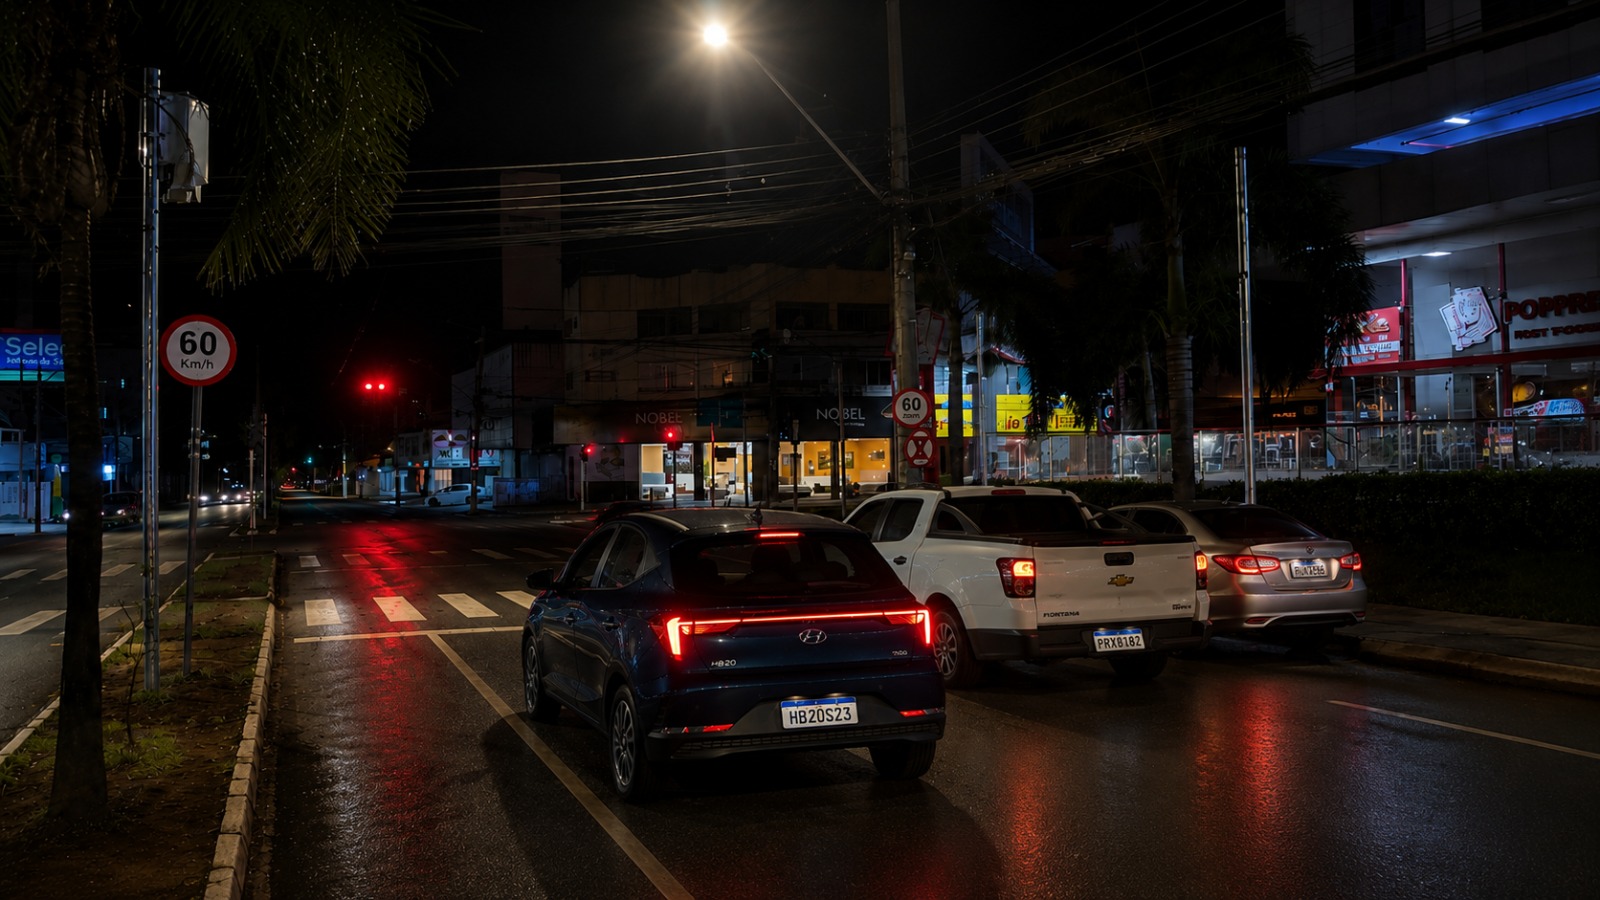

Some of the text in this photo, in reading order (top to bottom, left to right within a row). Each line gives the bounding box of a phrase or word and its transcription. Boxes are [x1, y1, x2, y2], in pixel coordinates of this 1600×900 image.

[180, 331, 217, 356] 60
[181, 359, 214, 369] Km/h
[902, 397, 921, 411] 60
[635, 411, 683, 424] NOBEL
[816, 407, 866, 420] NOBEL
[1097, 635, 1142, 649] PRX8182
[789, 706, 852, 725] HB20S23
